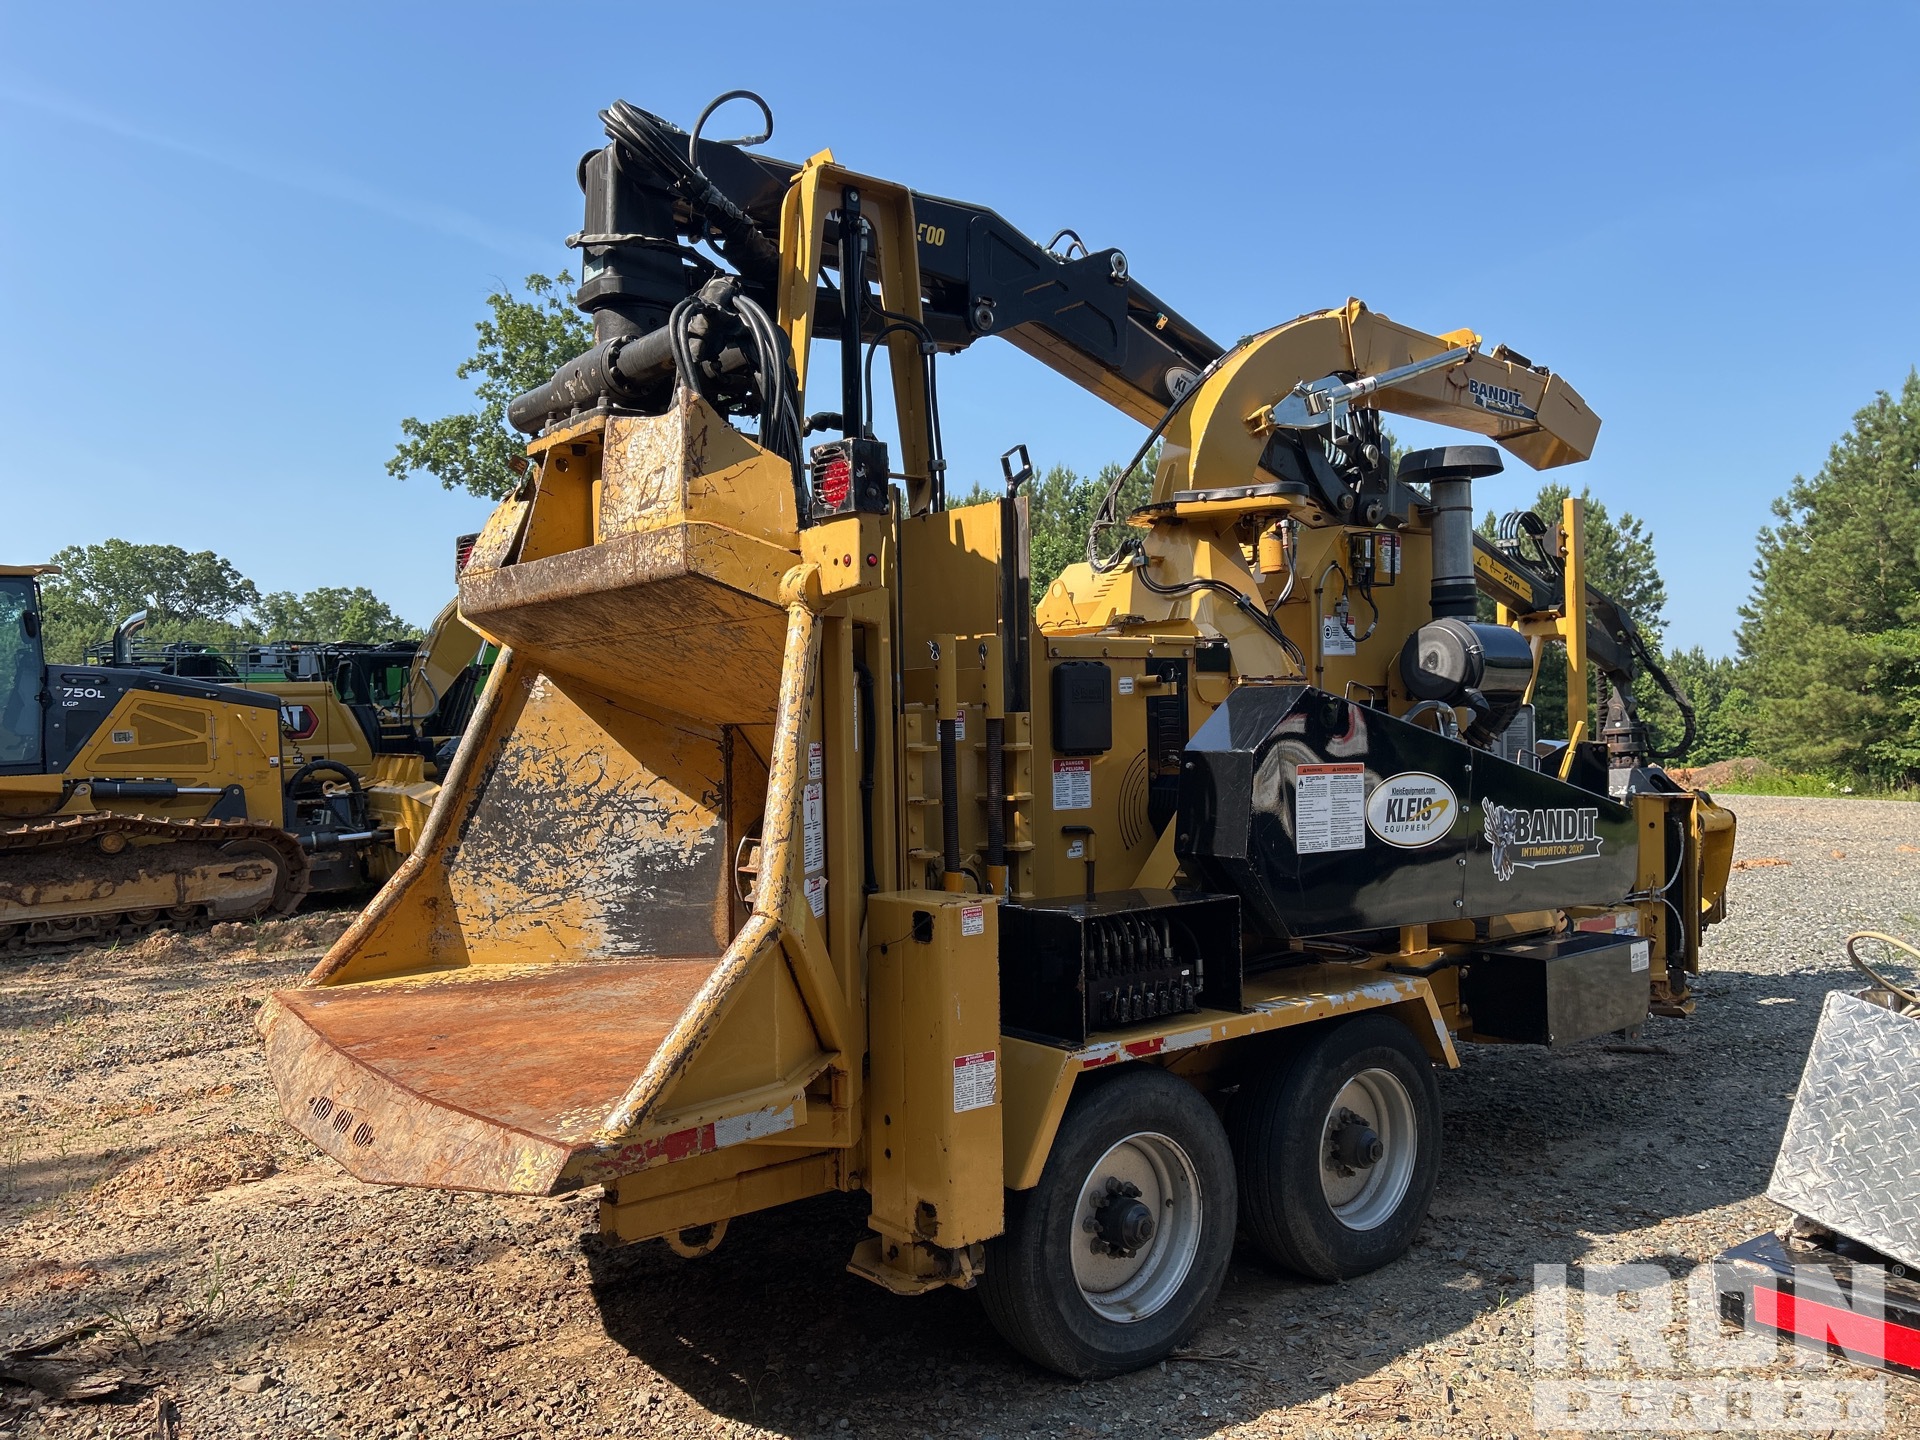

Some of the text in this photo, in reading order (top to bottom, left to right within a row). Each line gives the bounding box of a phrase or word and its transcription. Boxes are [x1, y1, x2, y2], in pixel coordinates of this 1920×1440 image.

[1469, 378, 1522, 407] BANDIT
[1503, 572, 1520, 590] 25m
[62, 687, 106, 699] 750L
[1391, 787, 1436, 796] KleisEquipment.com
[1385, 797, 1434, 823] KLEIS
[1384, 823, 1431, 833] EQUIPMENT
[1514, 809, 1598, 844] BANDIT
[1521, 844, 1585, 857] INTIMIDATOR 20XP
